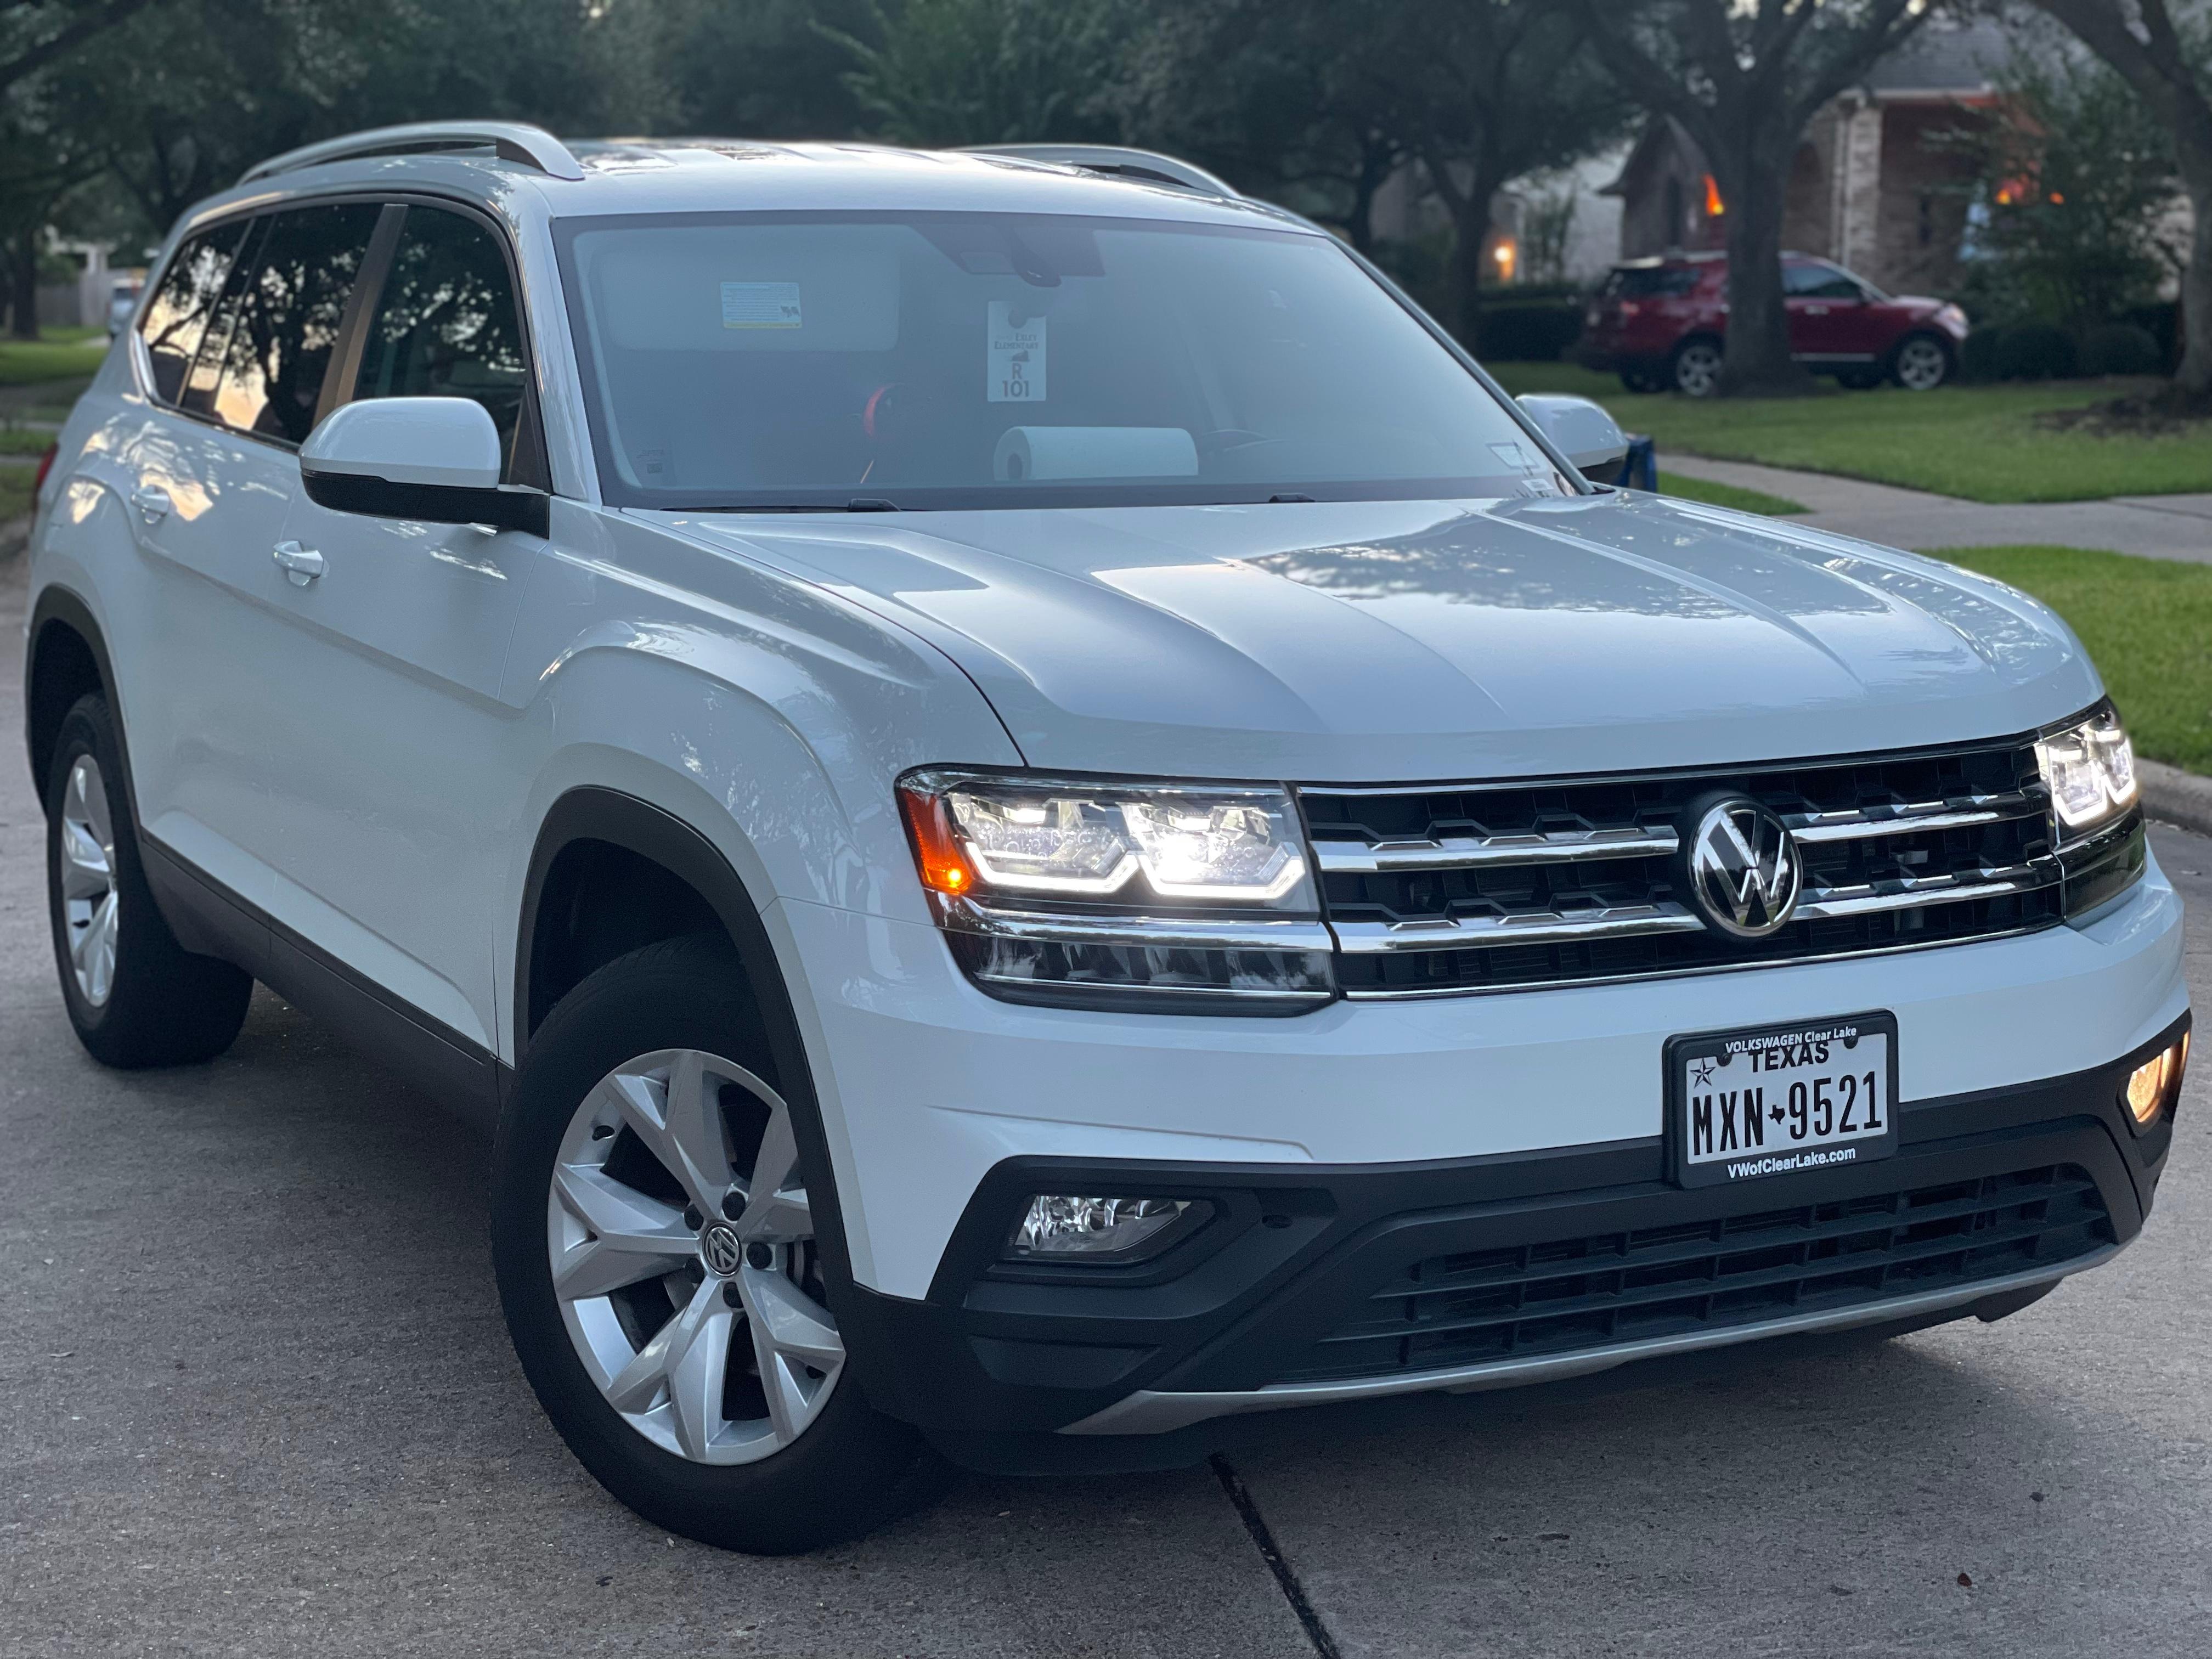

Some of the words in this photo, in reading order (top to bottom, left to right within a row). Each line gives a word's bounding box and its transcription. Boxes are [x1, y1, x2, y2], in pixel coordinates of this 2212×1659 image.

[994, 341, 1039, 349] ELEMENTARY
[1012, 363, 1022, 380] R
[1002, 380, 1030, 397] 101
[1725, 1032, 1802, 1053] VOLKSWAGEN
[1804, 1029, 1831, 1042] Clear
[1833, 1026, 1857, 1040] Lake
[1748, 1042, 1829, 1073] TEXAS
[1728, 1147, 1856, 1179] VWofClearLake.com
